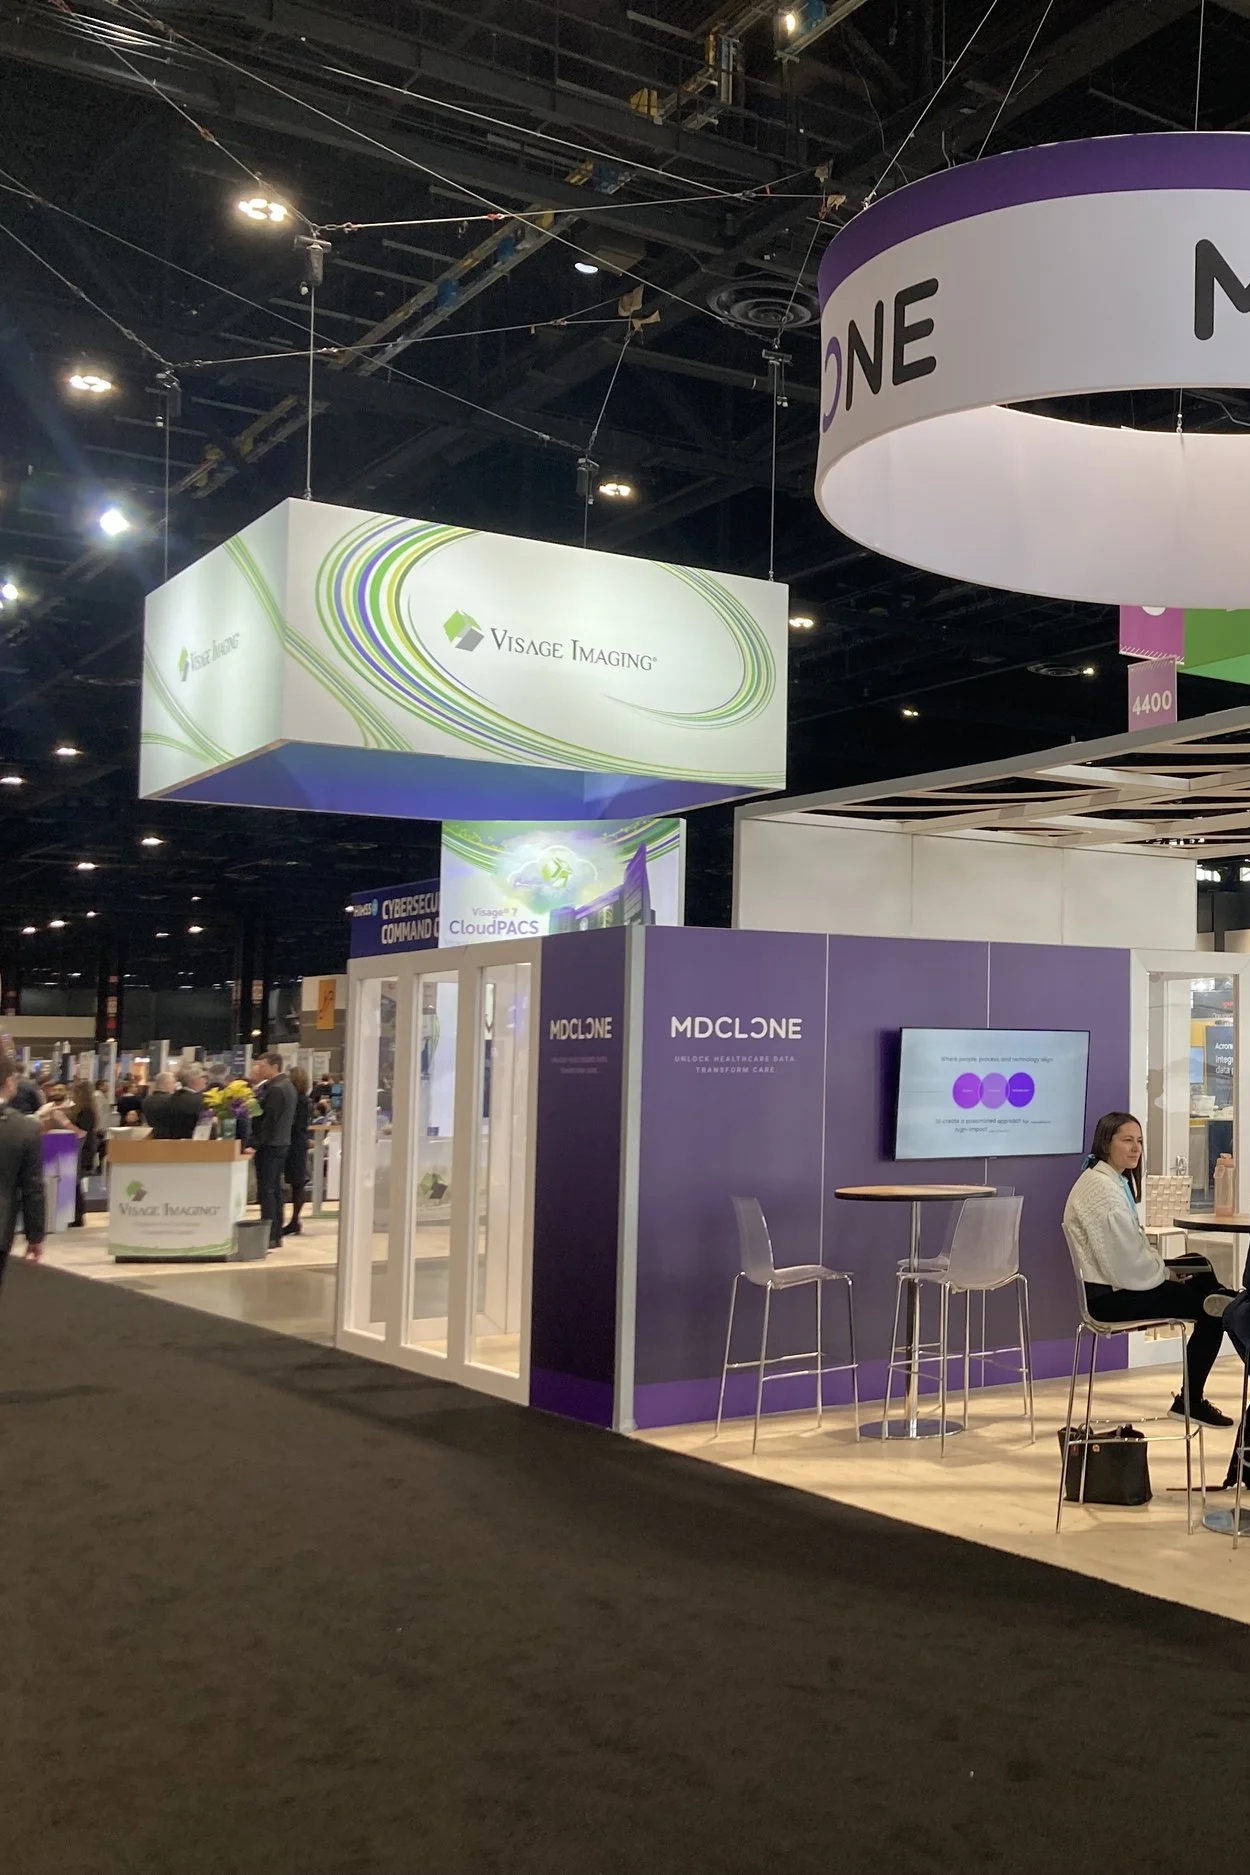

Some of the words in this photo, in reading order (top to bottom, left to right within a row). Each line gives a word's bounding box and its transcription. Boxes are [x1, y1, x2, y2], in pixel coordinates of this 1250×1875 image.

[490, 627, 564, 659] VISAGE
[1131, 690, 1173, 716] 4400
[382, 892, 440, 919] CYBERSECU
[512, 908, 518, 916] 7
[381, 918, 432, 944] COMMAND
[449, 920, 540, 935] CloudPACS
[550, 1016, 613, 1040] MDCLONE
[670, 1016, 803, 1040] MDCLONE
[1215, 1042, 1233, 1050] Acron
[674, 1055, 710, 1063] UNLOCK
[713, 1055, 770, 1063] HEALTHCARE
[695, 1066, 749, 1074] TRANSFORM
[1215, 1066, 1230, 1074] data
